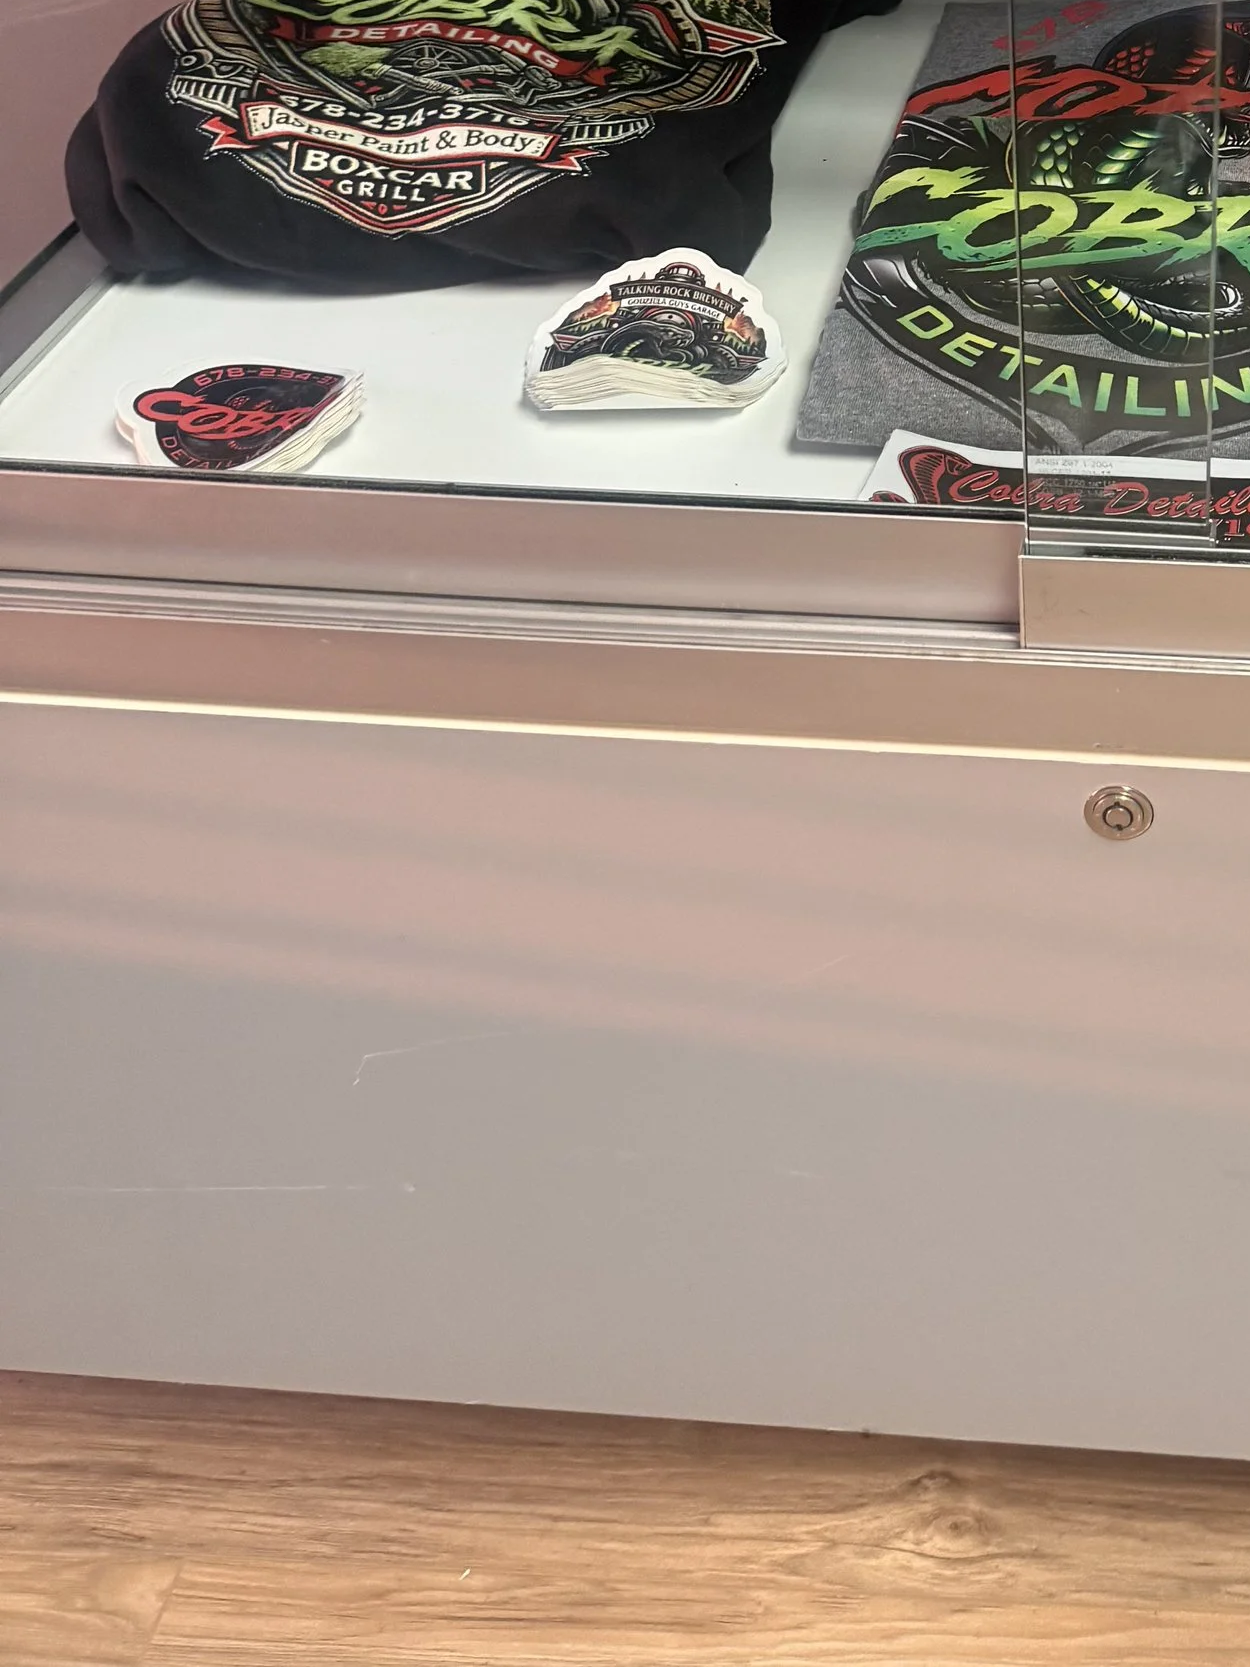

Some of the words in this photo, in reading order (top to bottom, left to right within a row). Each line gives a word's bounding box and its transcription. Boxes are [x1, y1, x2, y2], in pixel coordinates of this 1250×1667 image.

[321, 21, 562, 70] DETAILING
[262, 107, 352, 145] Jasper
[360, 132, 430, 156] Paint
[436, 130, 457, 151] &
[466, 129, 537, 153] Body
[279, 95, 530, 131] 678-234-3716
[302, 149, 474, 191] BOXCAR
[338, 179, 426, 203] GRILL
[617, 284, 662, 297] TALKING
[662, 285, 691, 299] ROCK
[692, 289, 737, 315] BREWERY
[668, 299, 690, 310] GUYS
[690, 302, 722, 320] GARAGE
[948, 469, 1086, 515] Cobra
